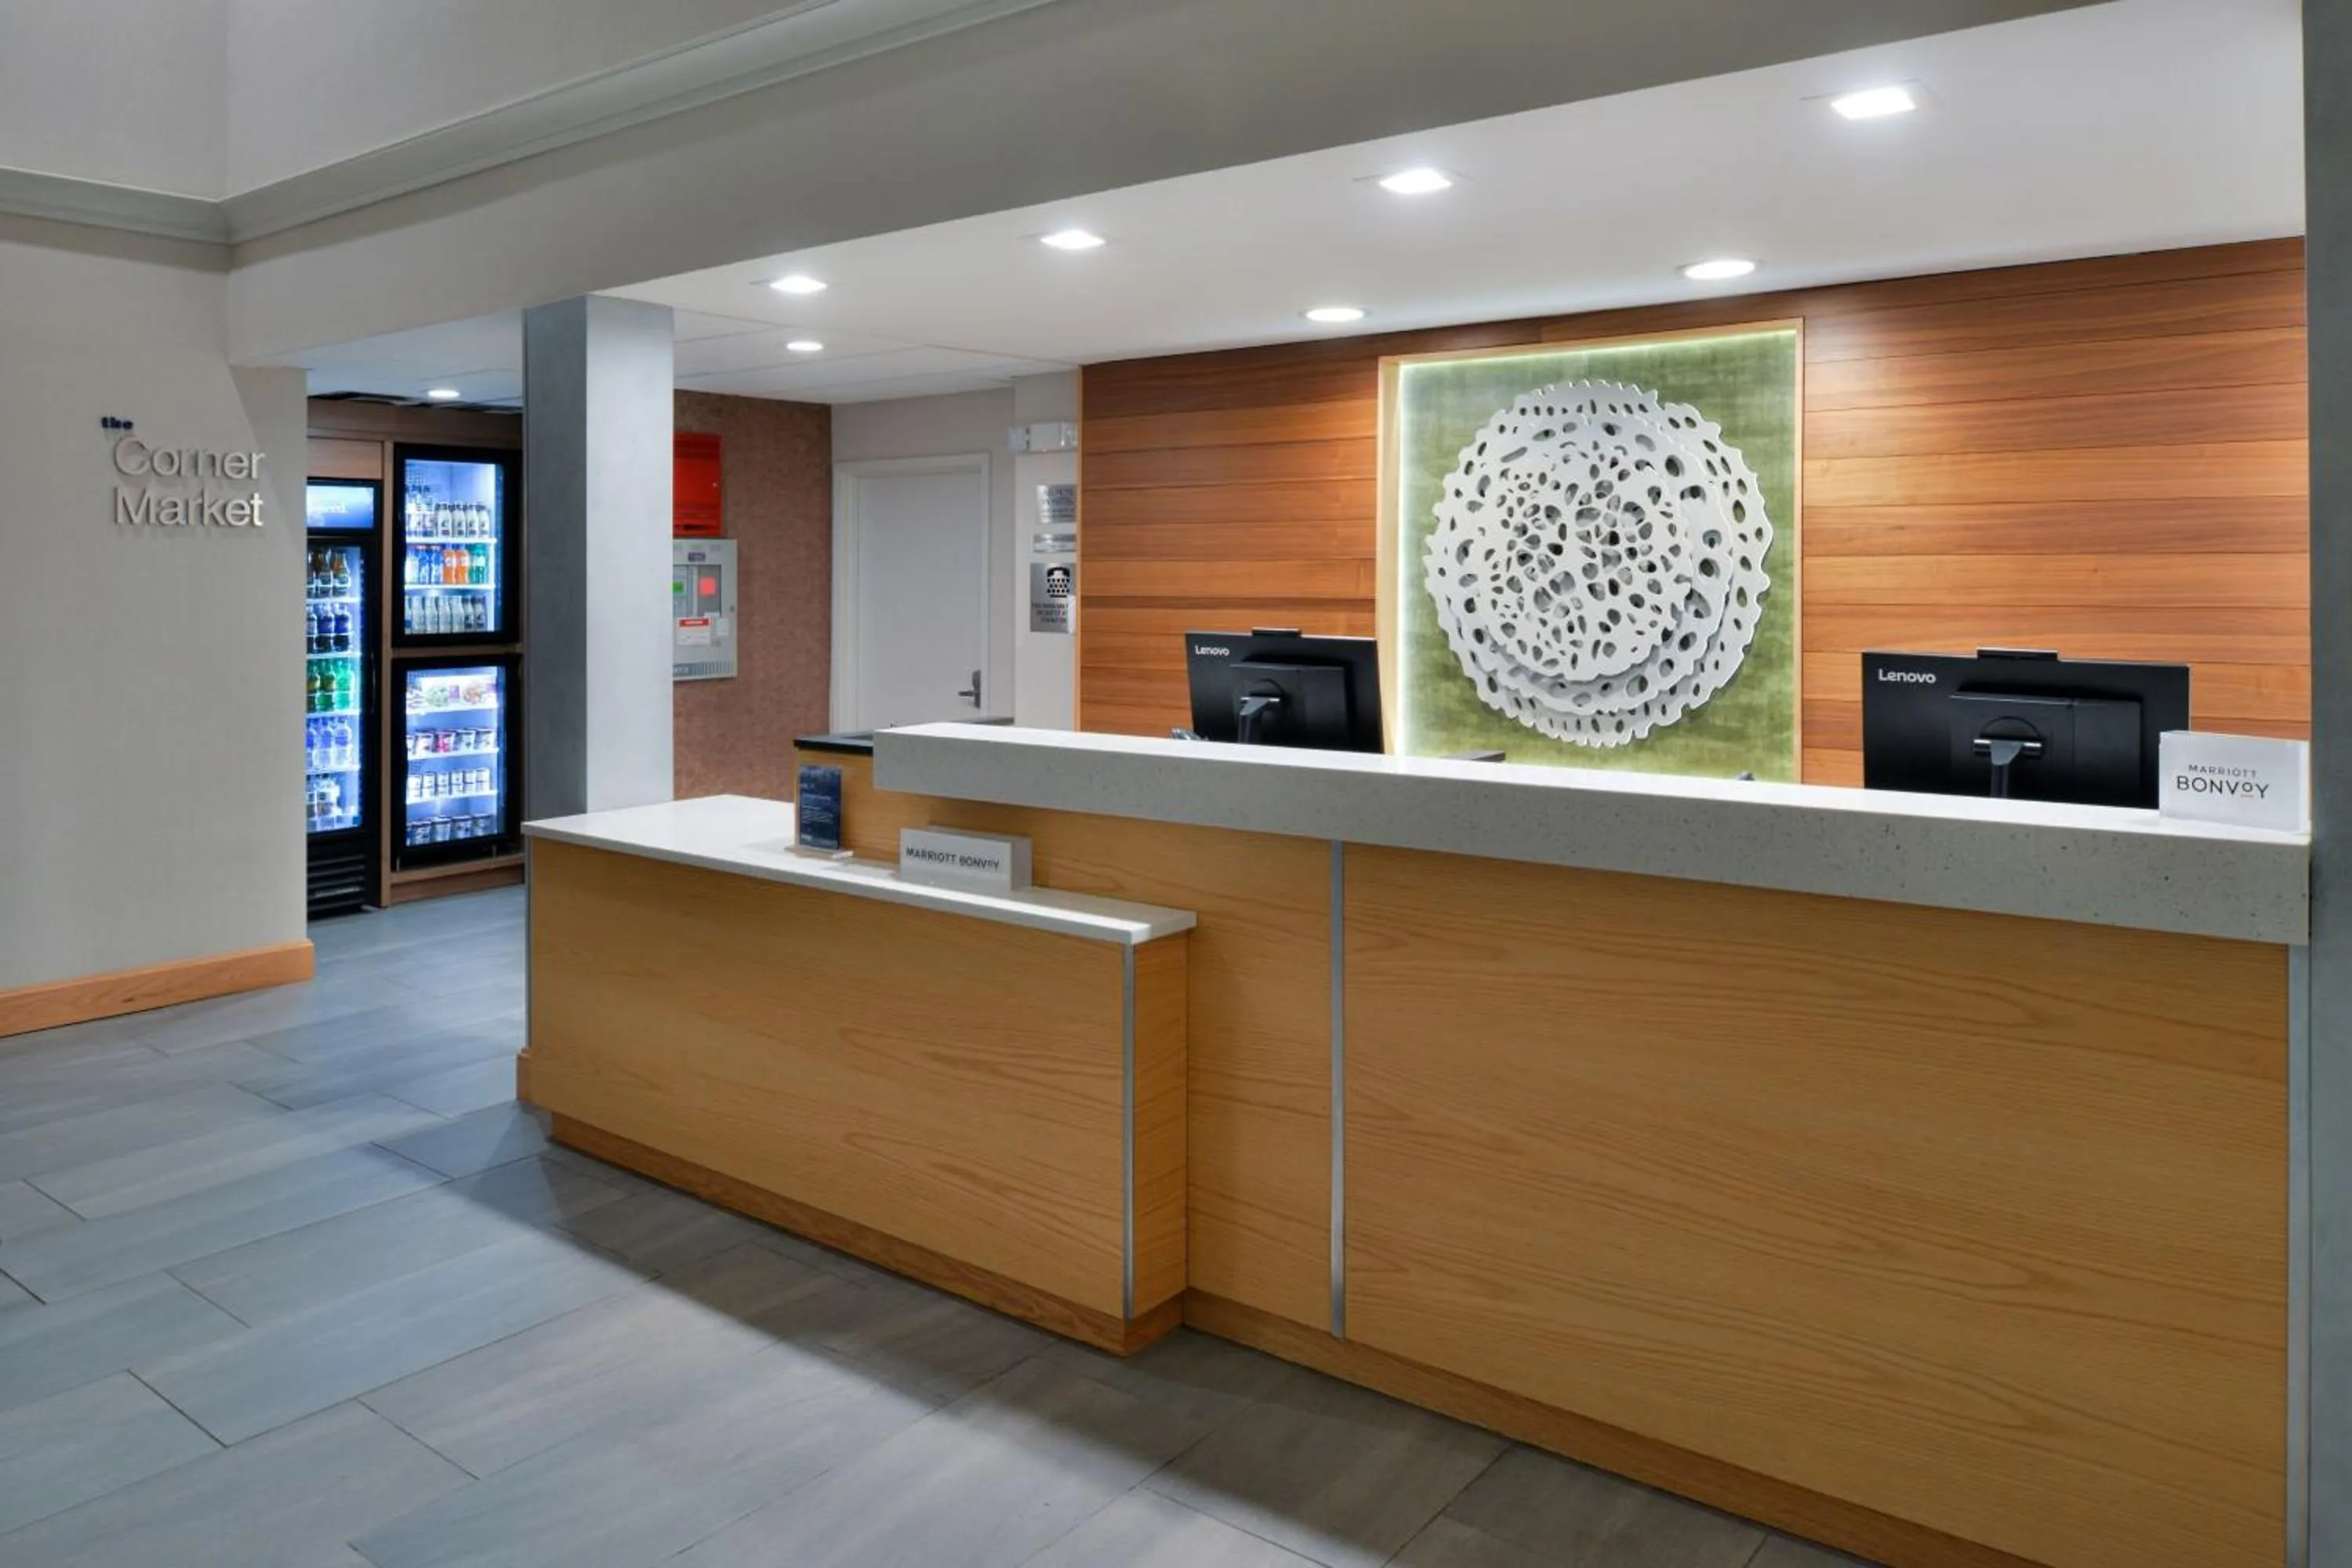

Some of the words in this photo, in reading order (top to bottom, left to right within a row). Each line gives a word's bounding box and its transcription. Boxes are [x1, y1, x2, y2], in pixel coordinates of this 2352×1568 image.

[100, 416, 134, 430] the
[114, 436, 266, 479] Corner
[114, 486, 264, 527] Market
[1195, 644, 1230, 656] Lenovo
[1878, 668, 1936, 684] Lenovo
[2188, 764, 2257, 778] MARRIOTT
[906, 847, 956, 863] MARRIOTT
